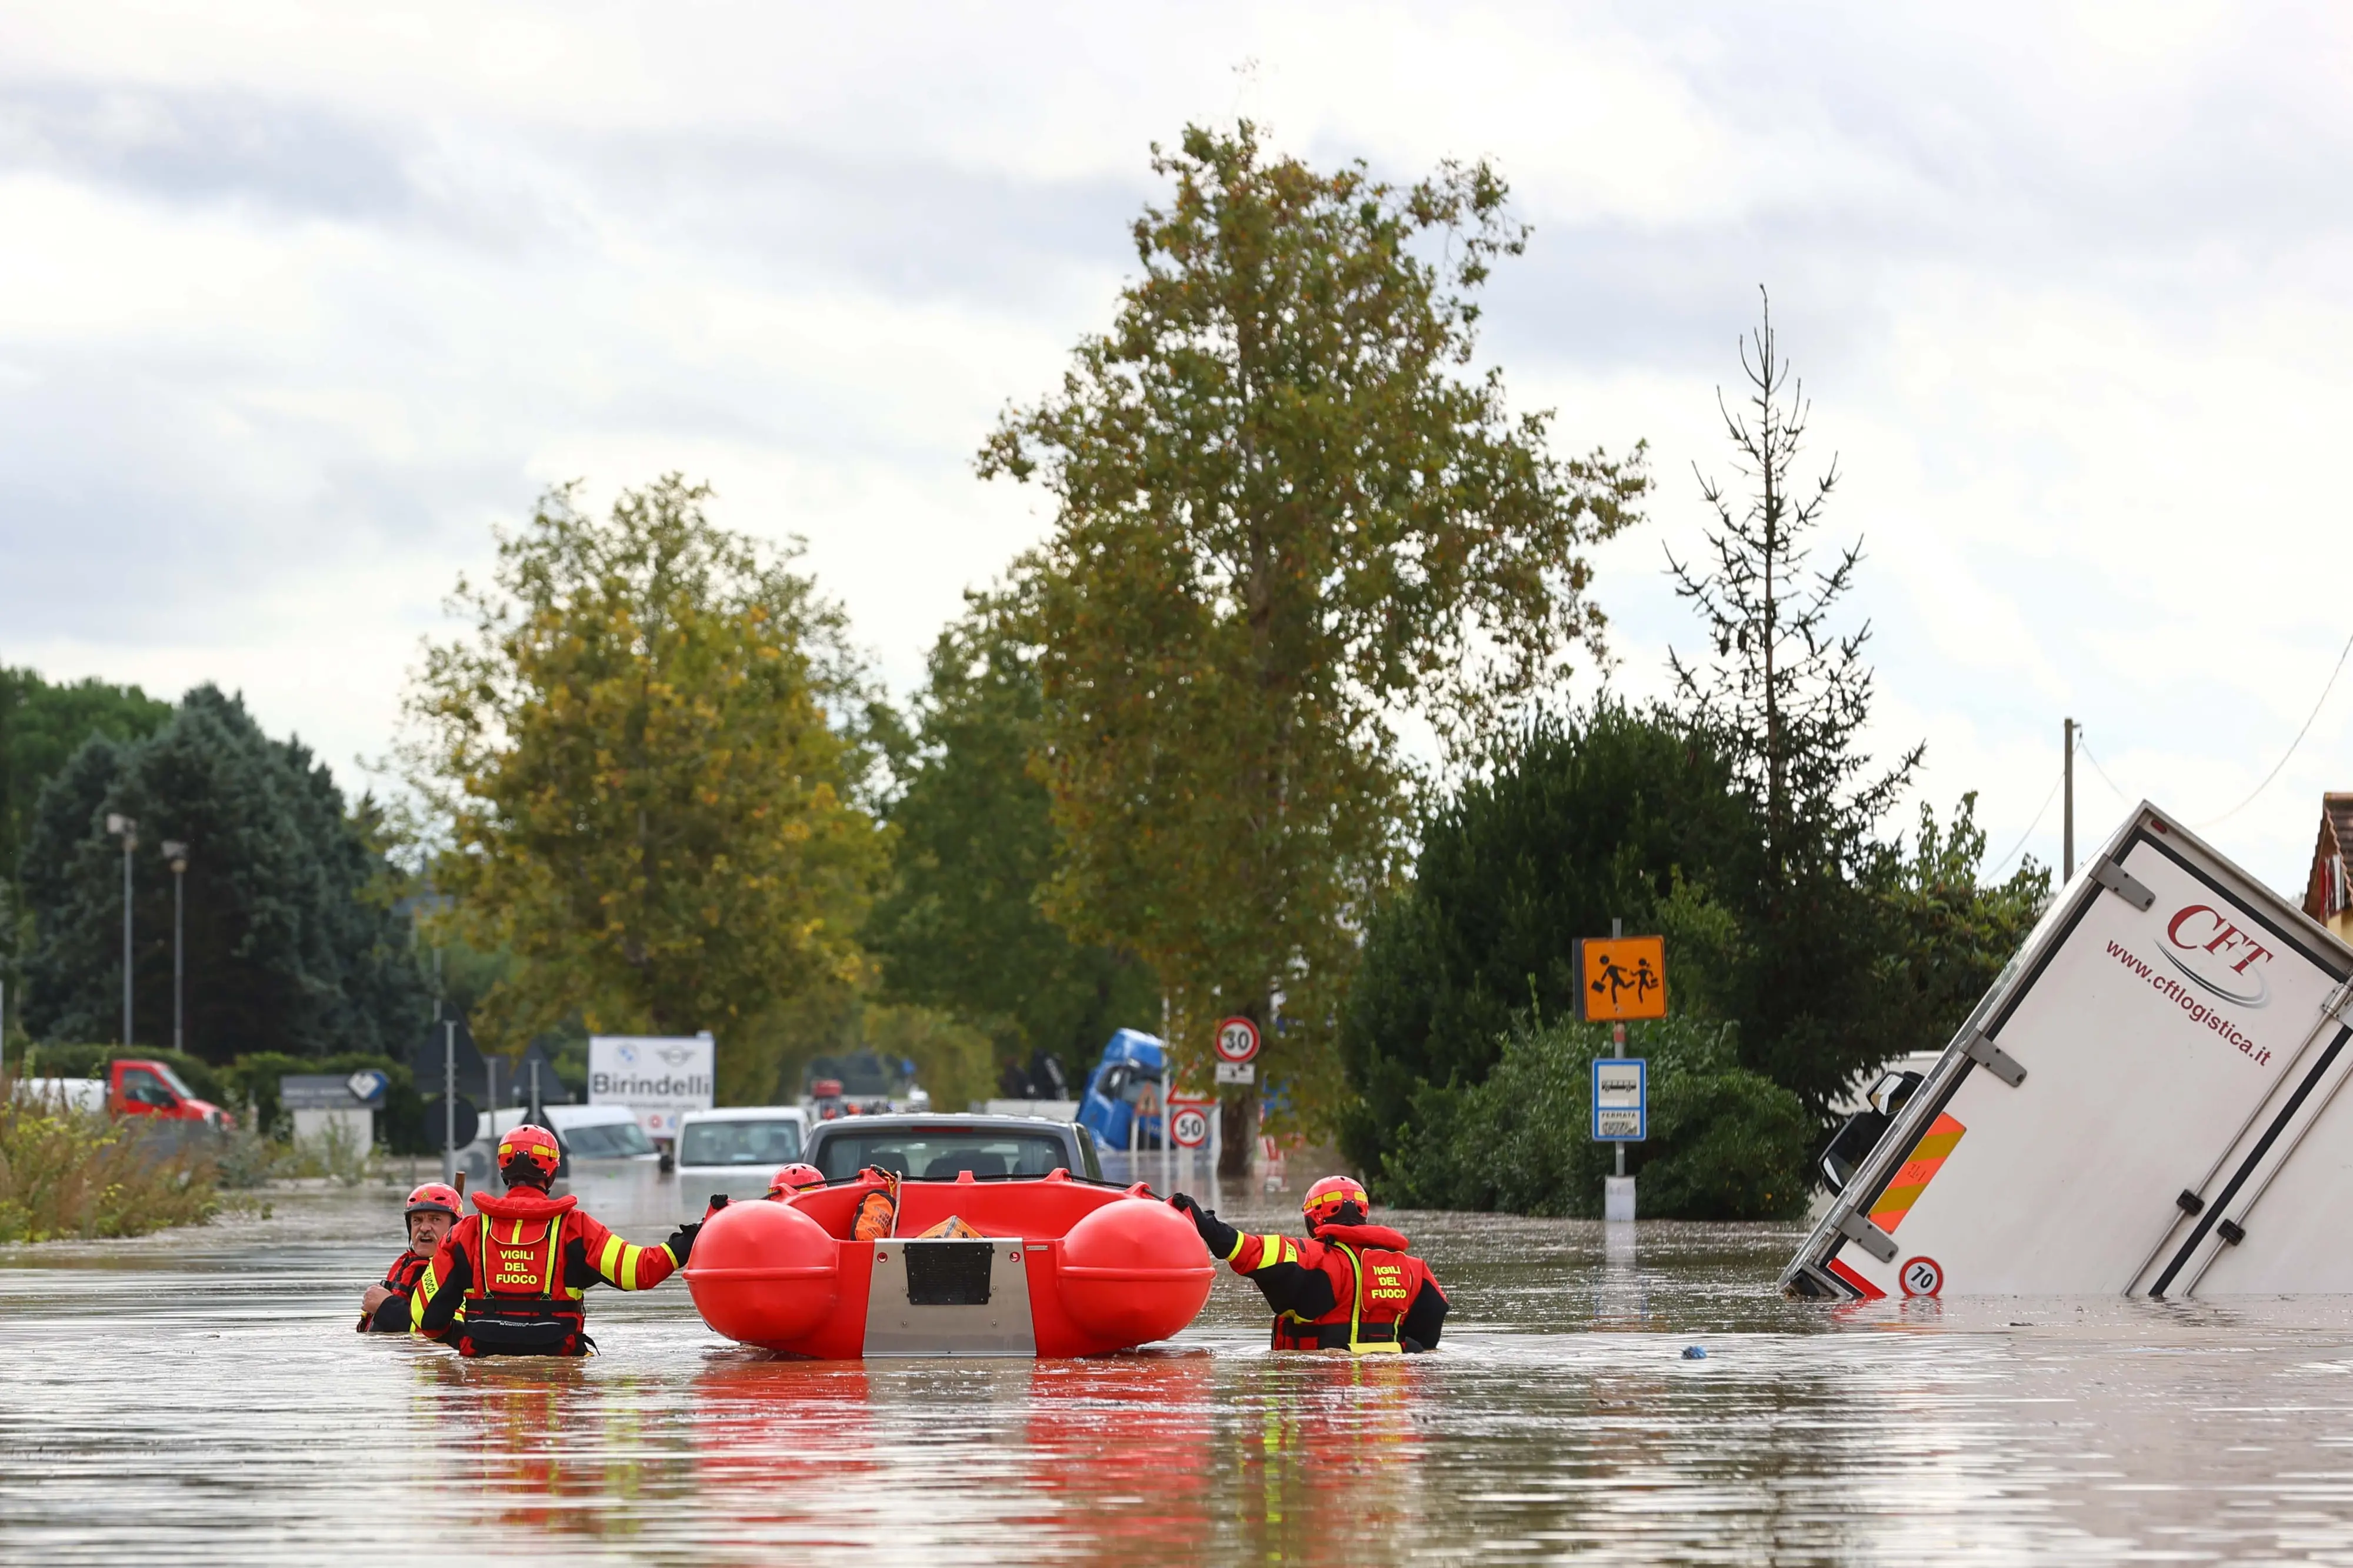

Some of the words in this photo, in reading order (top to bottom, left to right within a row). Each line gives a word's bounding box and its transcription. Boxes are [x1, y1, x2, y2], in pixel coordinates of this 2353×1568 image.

[2168, 905, 2274, 976] CFT
[2106, 939, 2271, 1066] www.cftlogistica.it
[1224, 1030, 1249, 1050] 30
[594, 1073, 711, 1095] Birindelli
[1180, 1118, 1201, 1137] 50
[499, 1250, 534, 1260] VIGILI
[504, 1262, 528, 1272] DEL
[424, 1272, 435, 1294] FUOCO
[496, 1274, 538, 1285] FUOCO
[1378, 1276, 1401, 1286] DEL
[1911, 1265, 1934, 1289] 70
[1371, 1288, 1407, 1299] FUOCO
